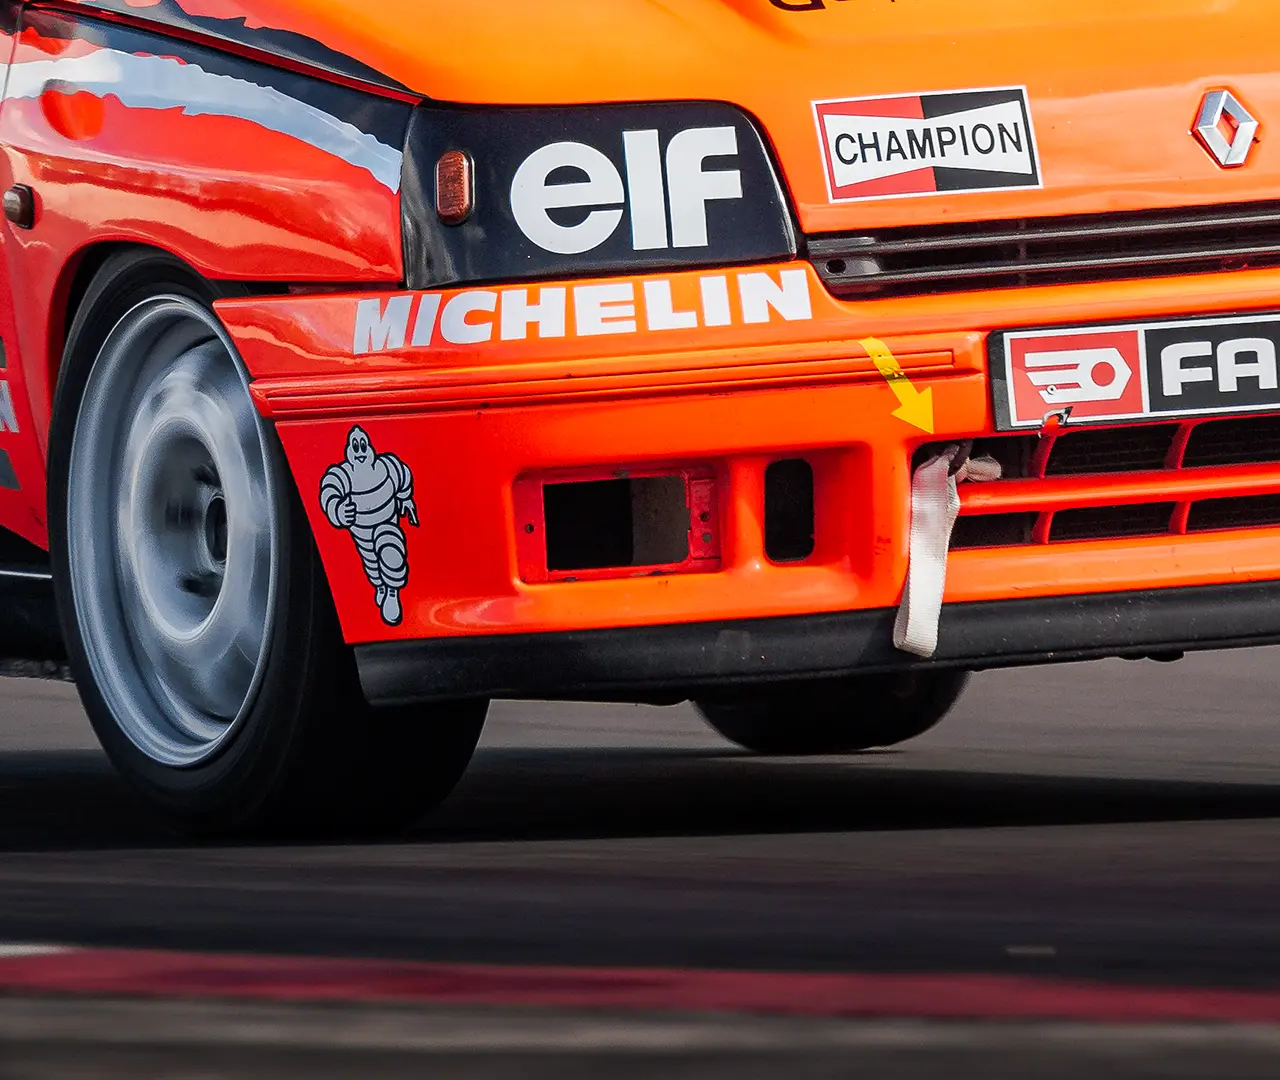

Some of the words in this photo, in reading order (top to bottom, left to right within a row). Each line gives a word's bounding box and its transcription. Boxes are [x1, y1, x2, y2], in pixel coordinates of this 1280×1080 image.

[833, 120, 1023, 165] CHAMPION
[510, 125, 743, 256] elf
[353, 268, 812, 355] MICHELIN
